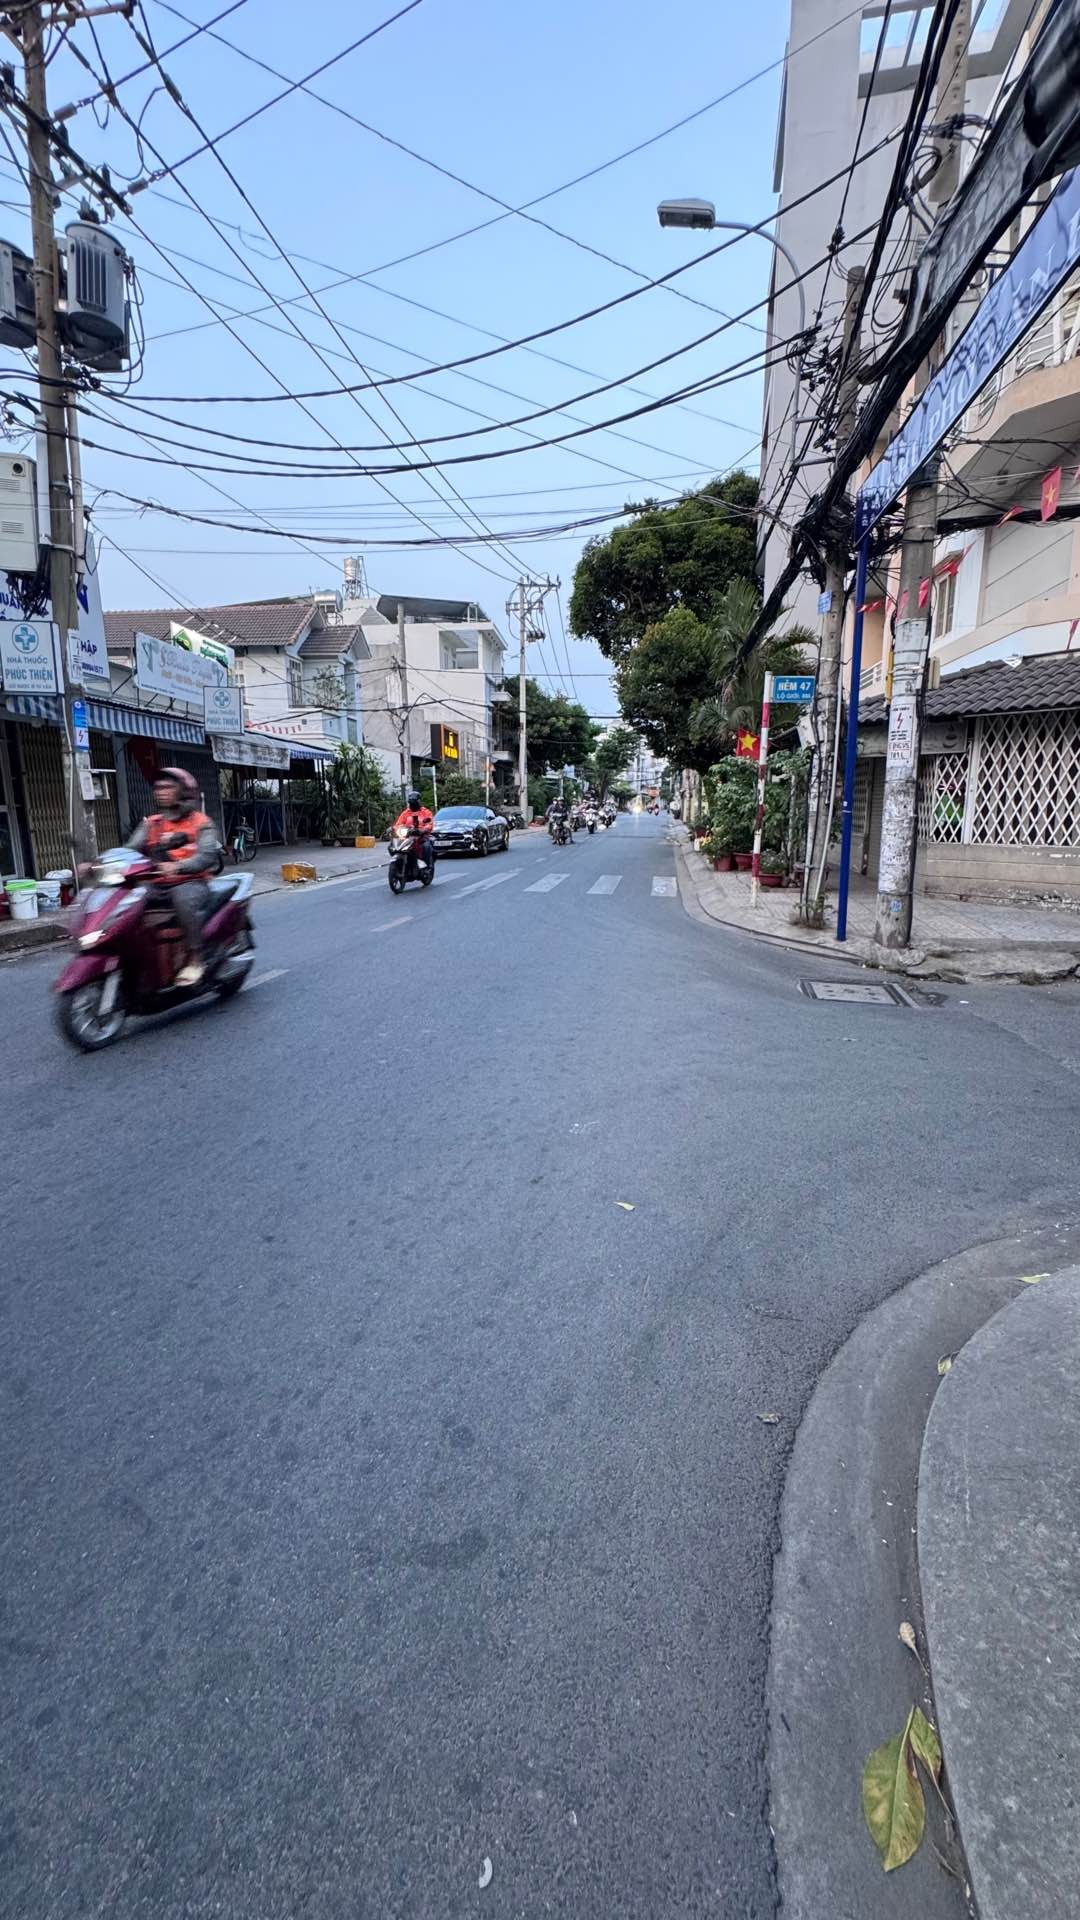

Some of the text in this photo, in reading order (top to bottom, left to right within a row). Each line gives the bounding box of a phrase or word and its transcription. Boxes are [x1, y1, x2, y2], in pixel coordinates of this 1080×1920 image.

[5, 667, 53, 683] PHÚC THIỆN
[799, 681, 812, 691] 47
